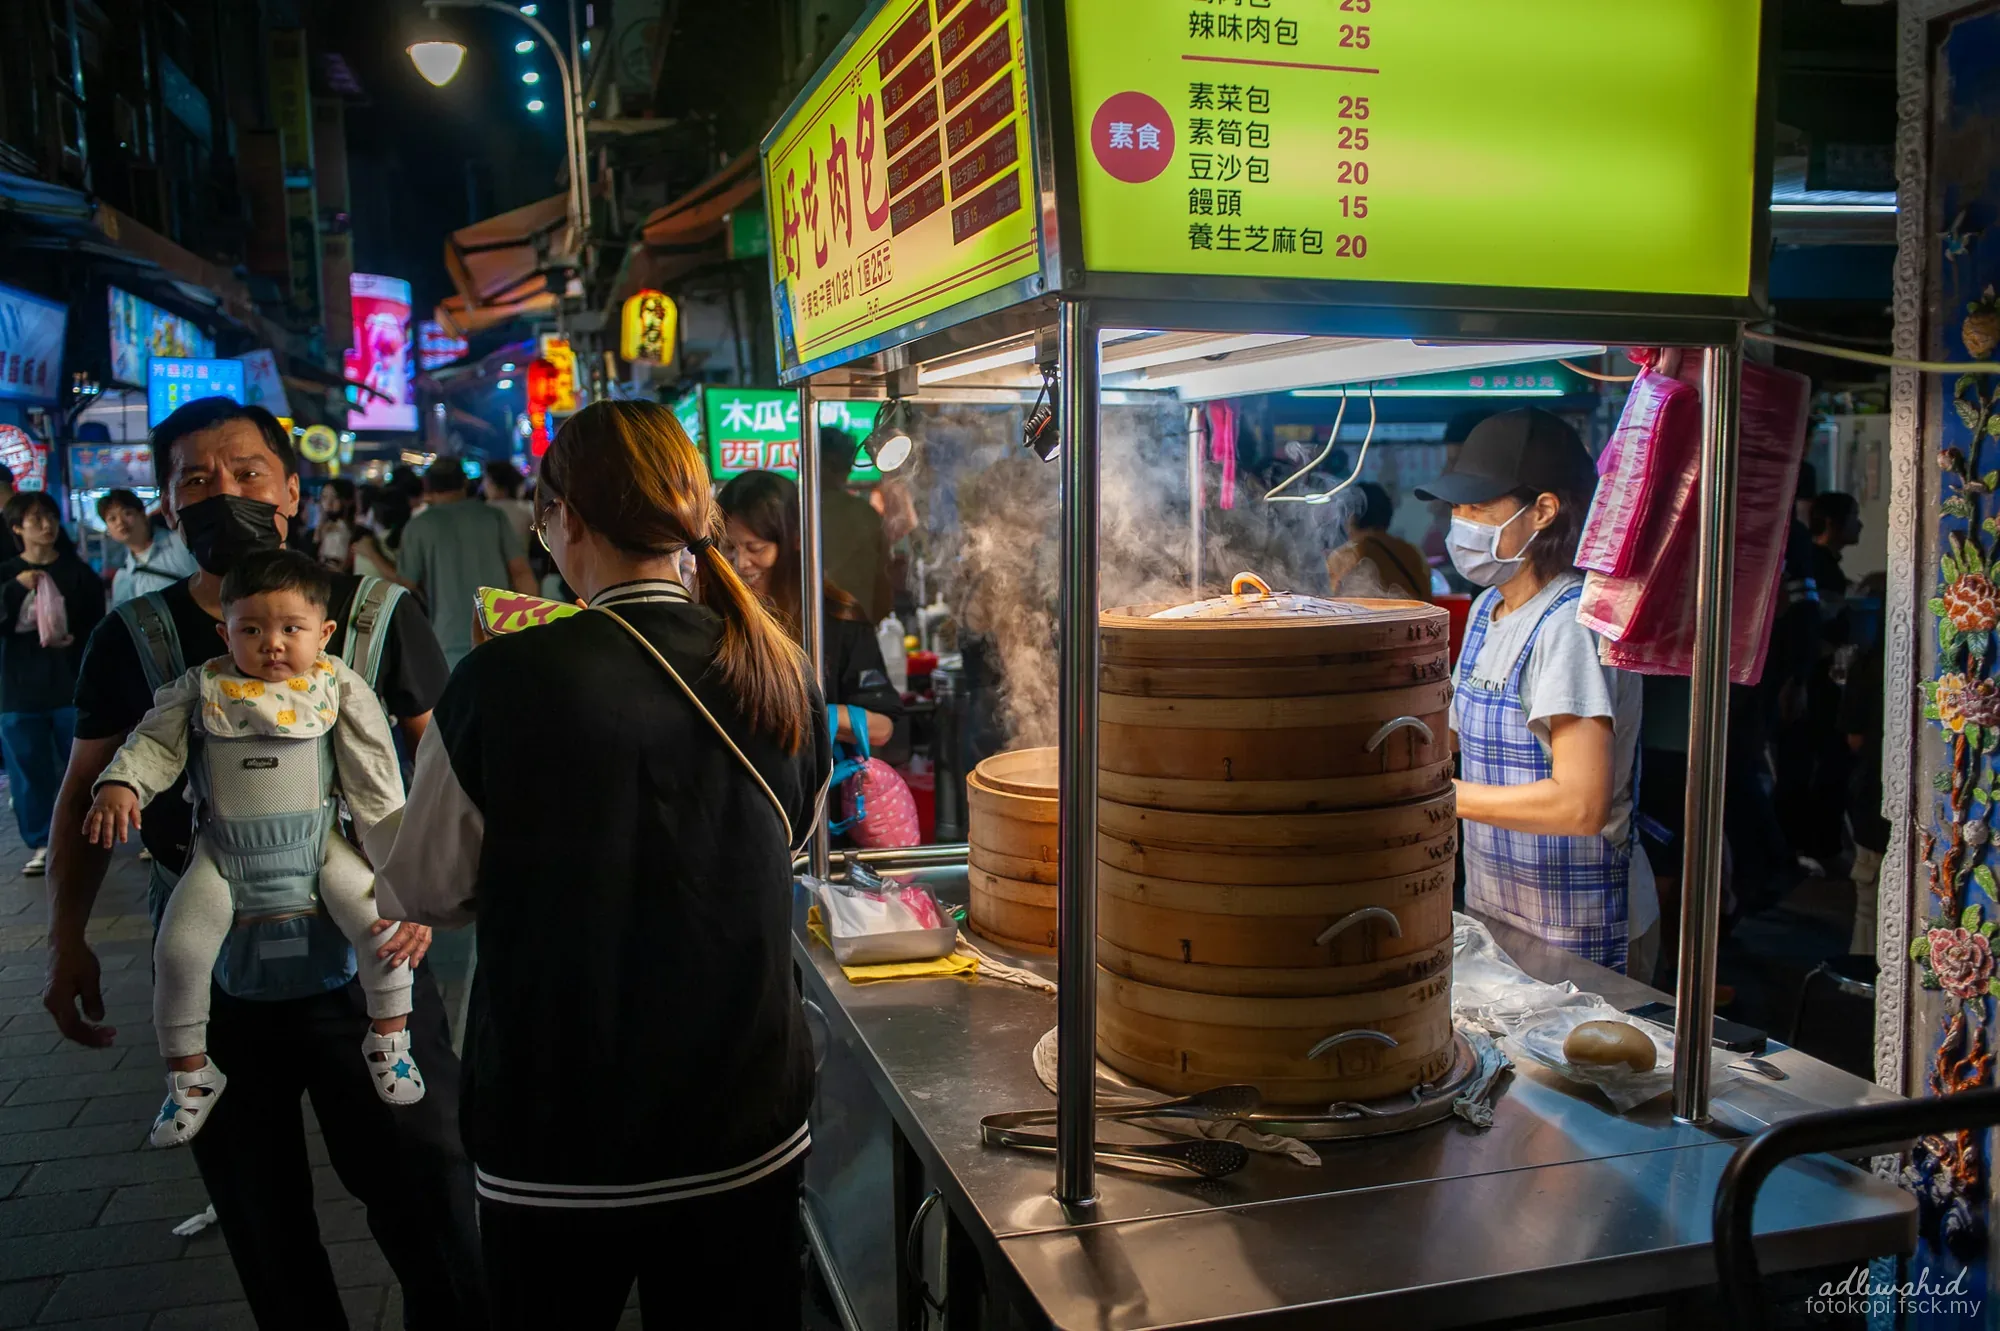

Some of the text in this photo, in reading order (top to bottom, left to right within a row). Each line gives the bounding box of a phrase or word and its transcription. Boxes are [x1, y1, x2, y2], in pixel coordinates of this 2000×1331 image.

[1189, 10, 1371, 50] 辣味肉包 25
[1189, 82, 1370, 120] 素菜包 25
[1109, 122, 1161, 151] 素食
[1189, 117, 1369, 151] 素筍包 25
[1189, 153, 1369, 185] 豆沙包 20
[781, 93, 890, 281] 好吃肉包
[1189, 188, 1368, 219] 饅頭 15
[1188, 222, 1368, 259] 養生芝麻包 20
